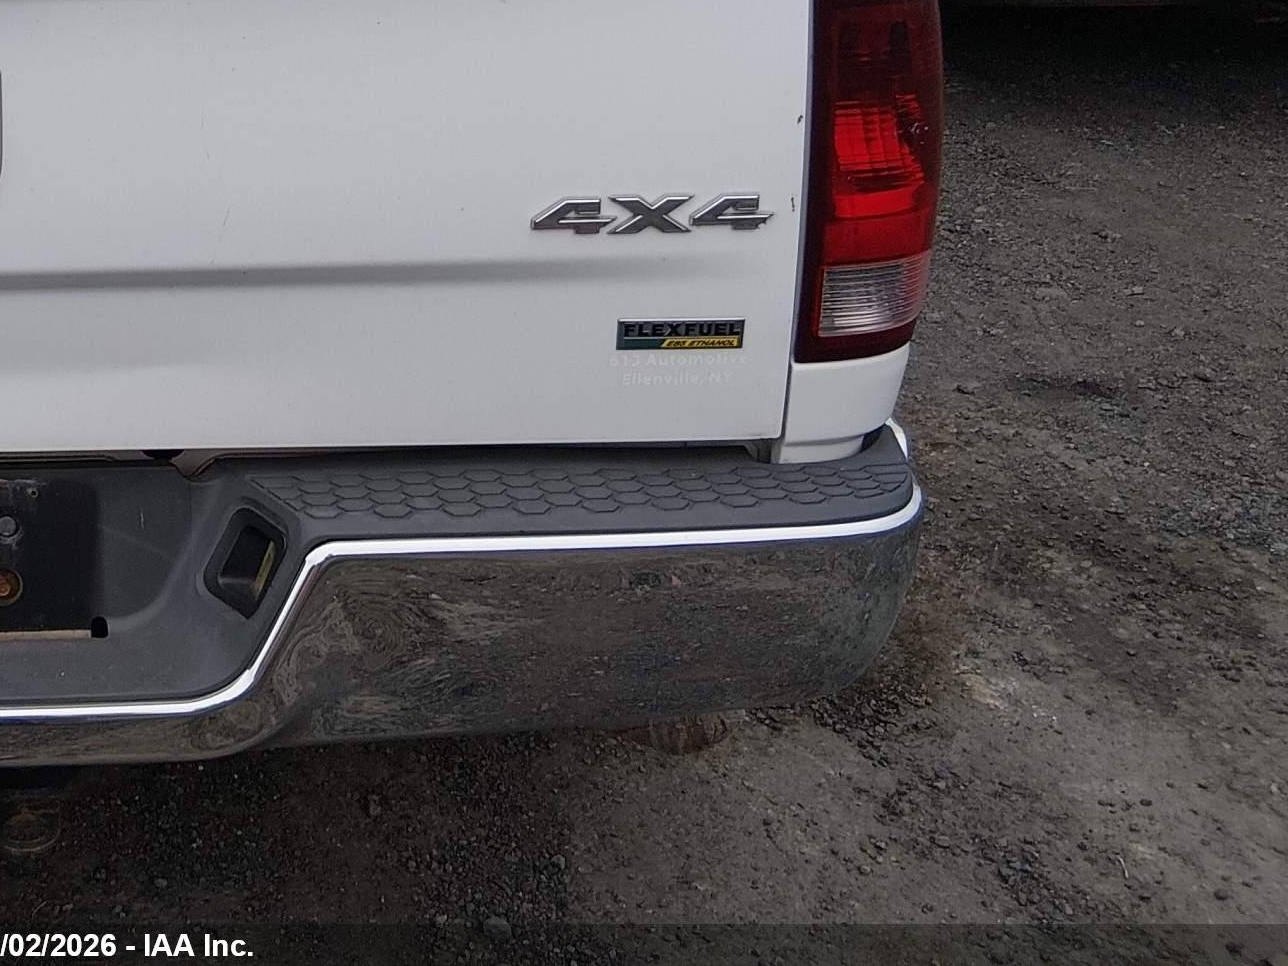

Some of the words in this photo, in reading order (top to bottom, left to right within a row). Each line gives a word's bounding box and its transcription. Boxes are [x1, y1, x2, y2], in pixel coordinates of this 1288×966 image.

[623, 322, 741, 336] FLEXFUEL
[666, 339, 687, 347] E85
[688, 338, 735, 347] ETHANOL
